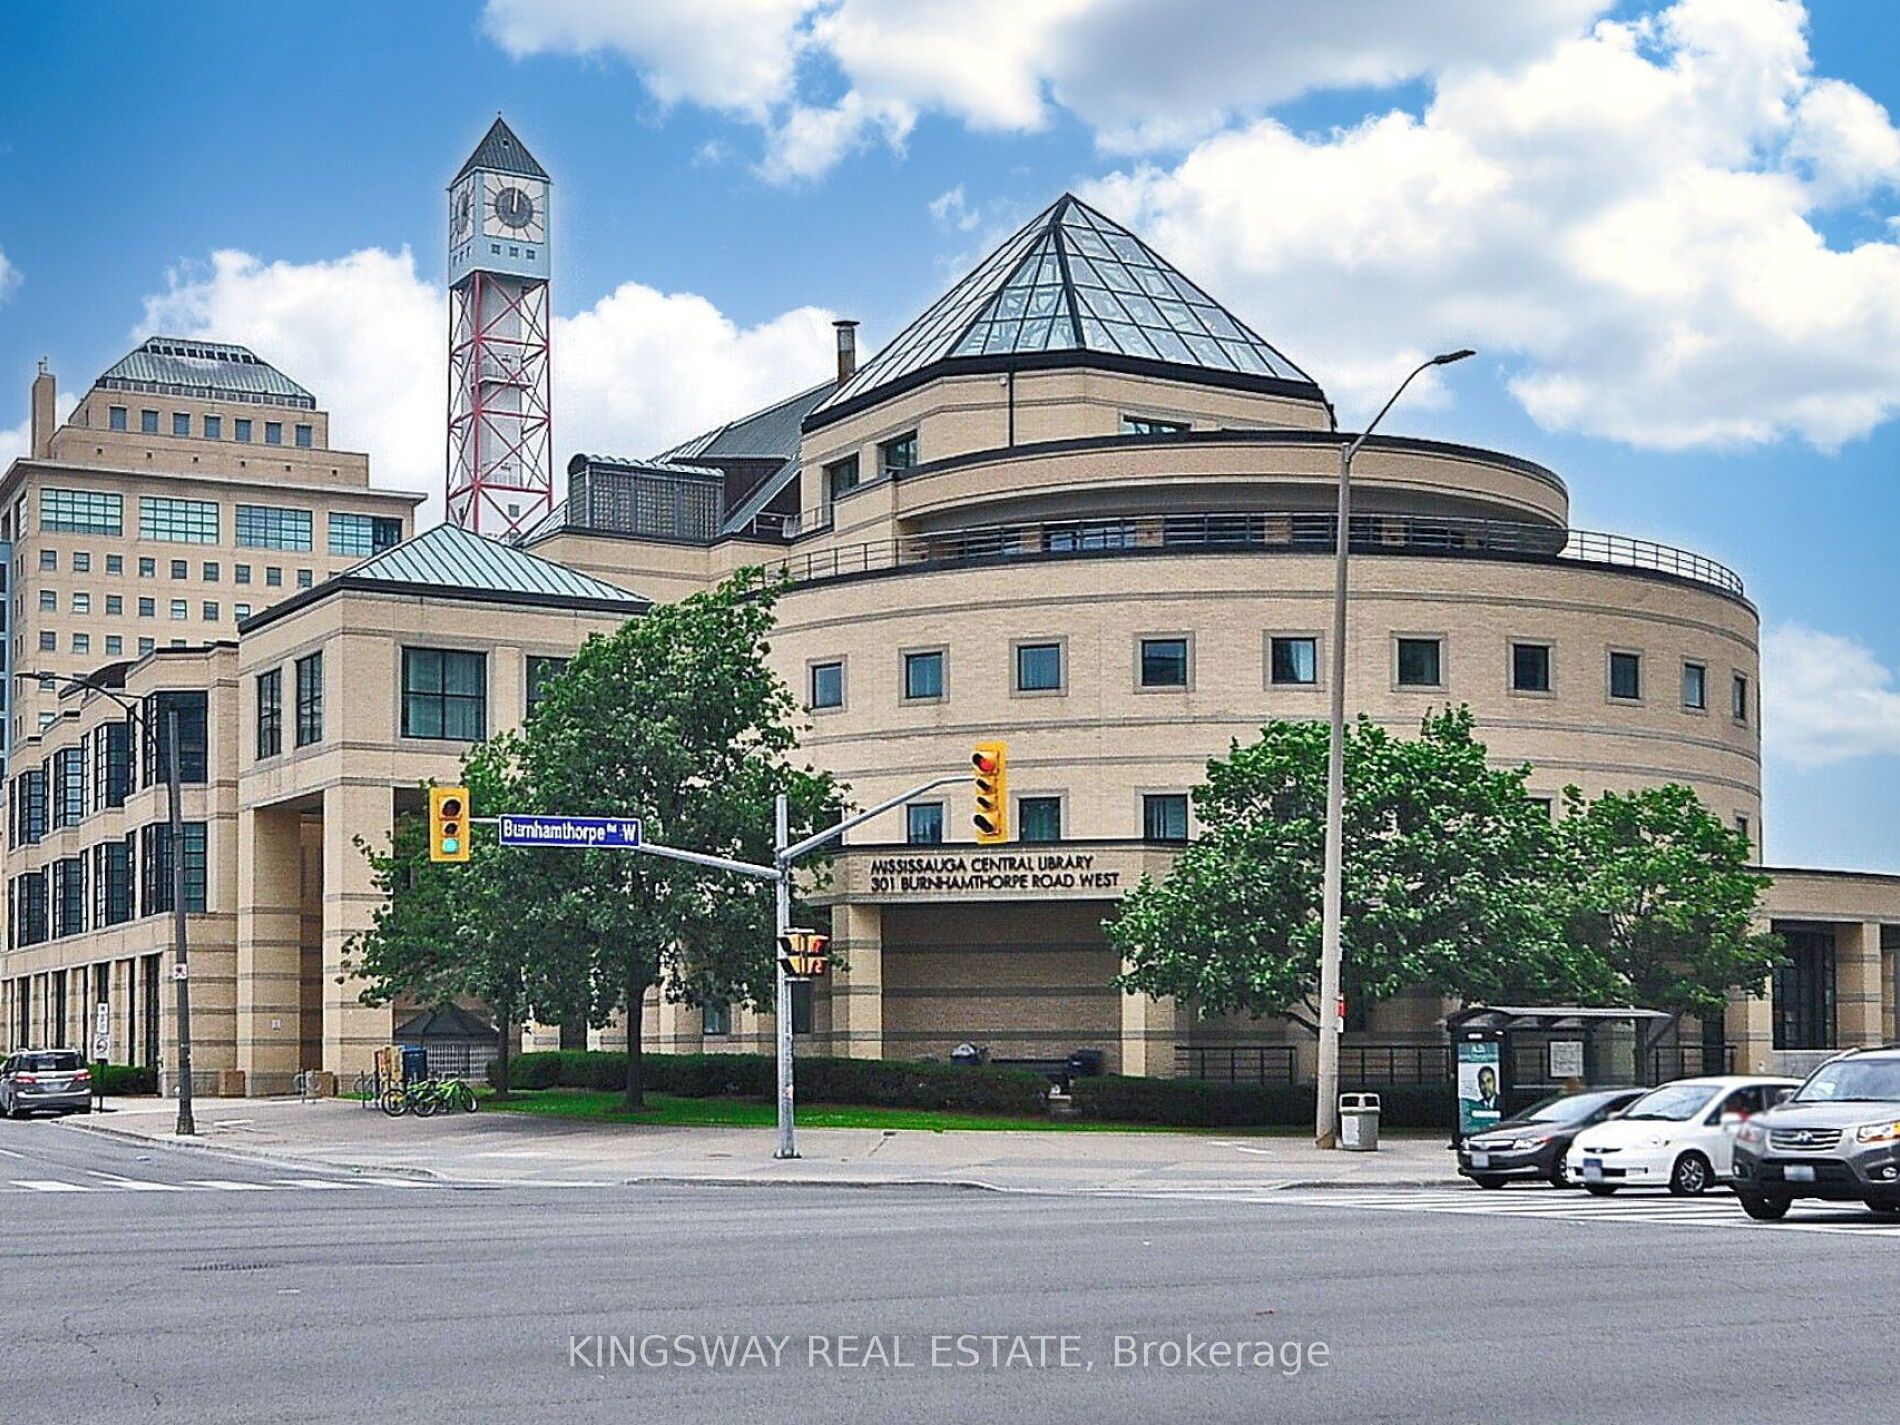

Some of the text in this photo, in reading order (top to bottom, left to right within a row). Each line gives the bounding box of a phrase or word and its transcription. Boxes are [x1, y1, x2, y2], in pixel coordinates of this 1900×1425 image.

[503, 819, 606, 845] Burnhamthorpe
[622, 823, 637, 842] W
[871, 854, 1094, 875] MISSISSAUGA CENTRAL LIBRARY
[871, 871, 1119, 892] 301 BURNHAMTHORPE ROAD WEST
